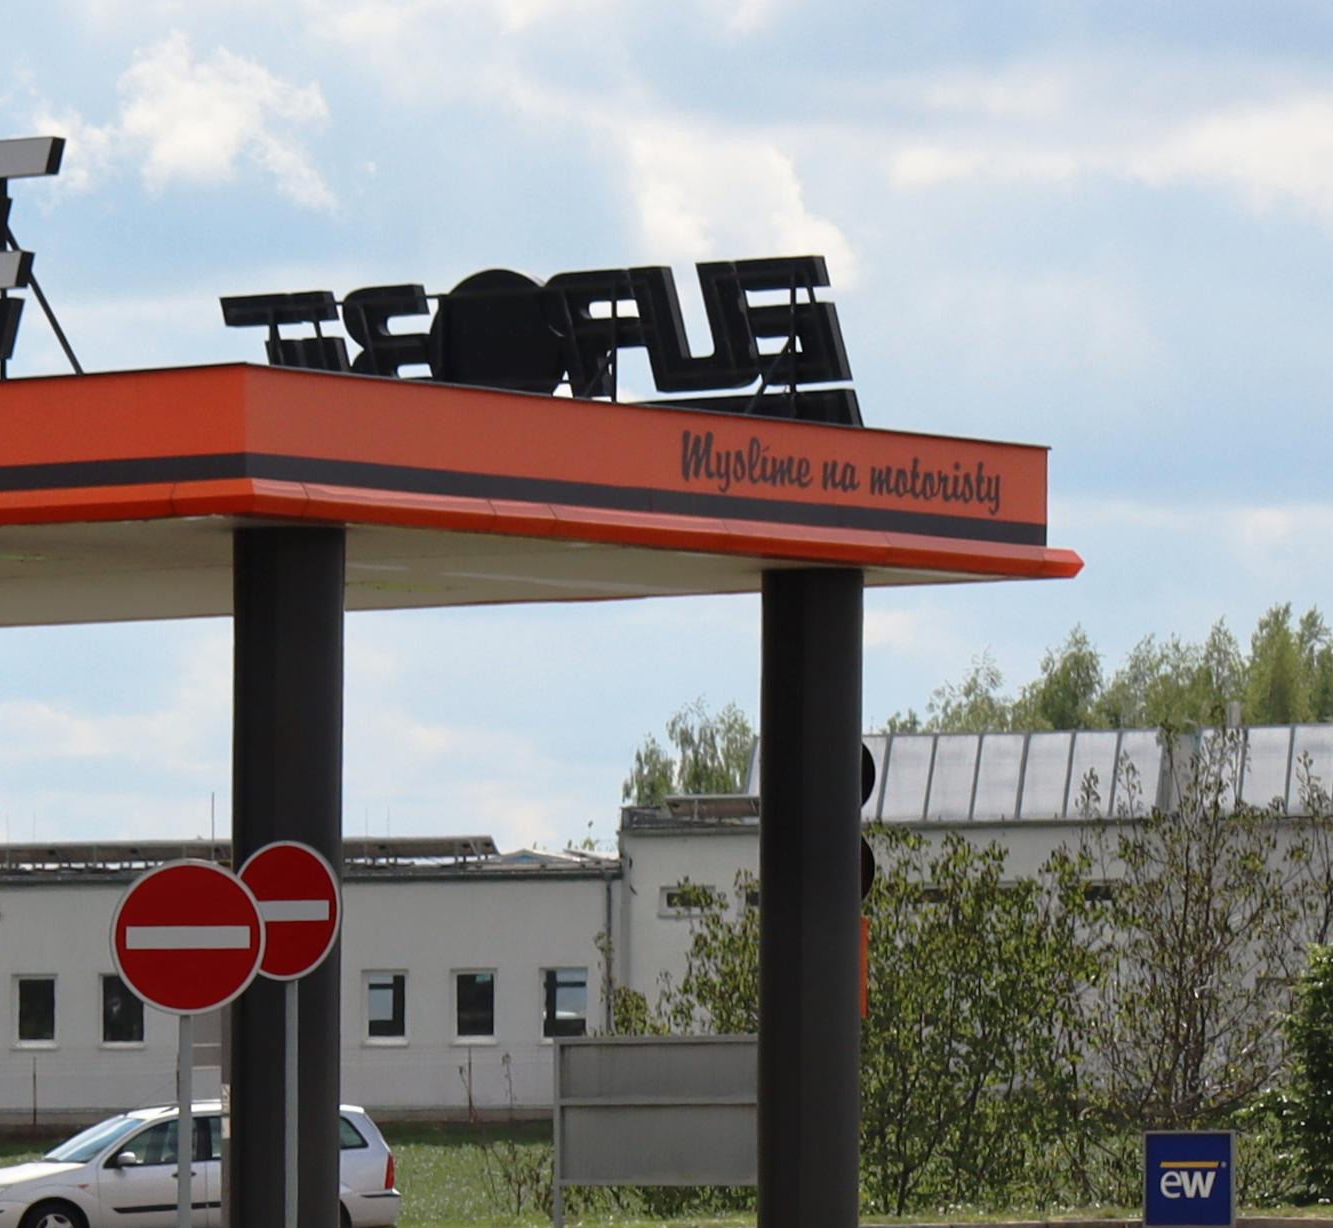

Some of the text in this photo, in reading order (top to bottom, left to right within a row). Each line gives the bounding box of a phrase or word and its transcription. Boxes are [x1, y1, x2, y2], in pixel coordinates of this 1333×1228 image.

[681, 430, 1001, 516] Myslíme na motoristy
[1160, 1171, 1216, 1198] ew
